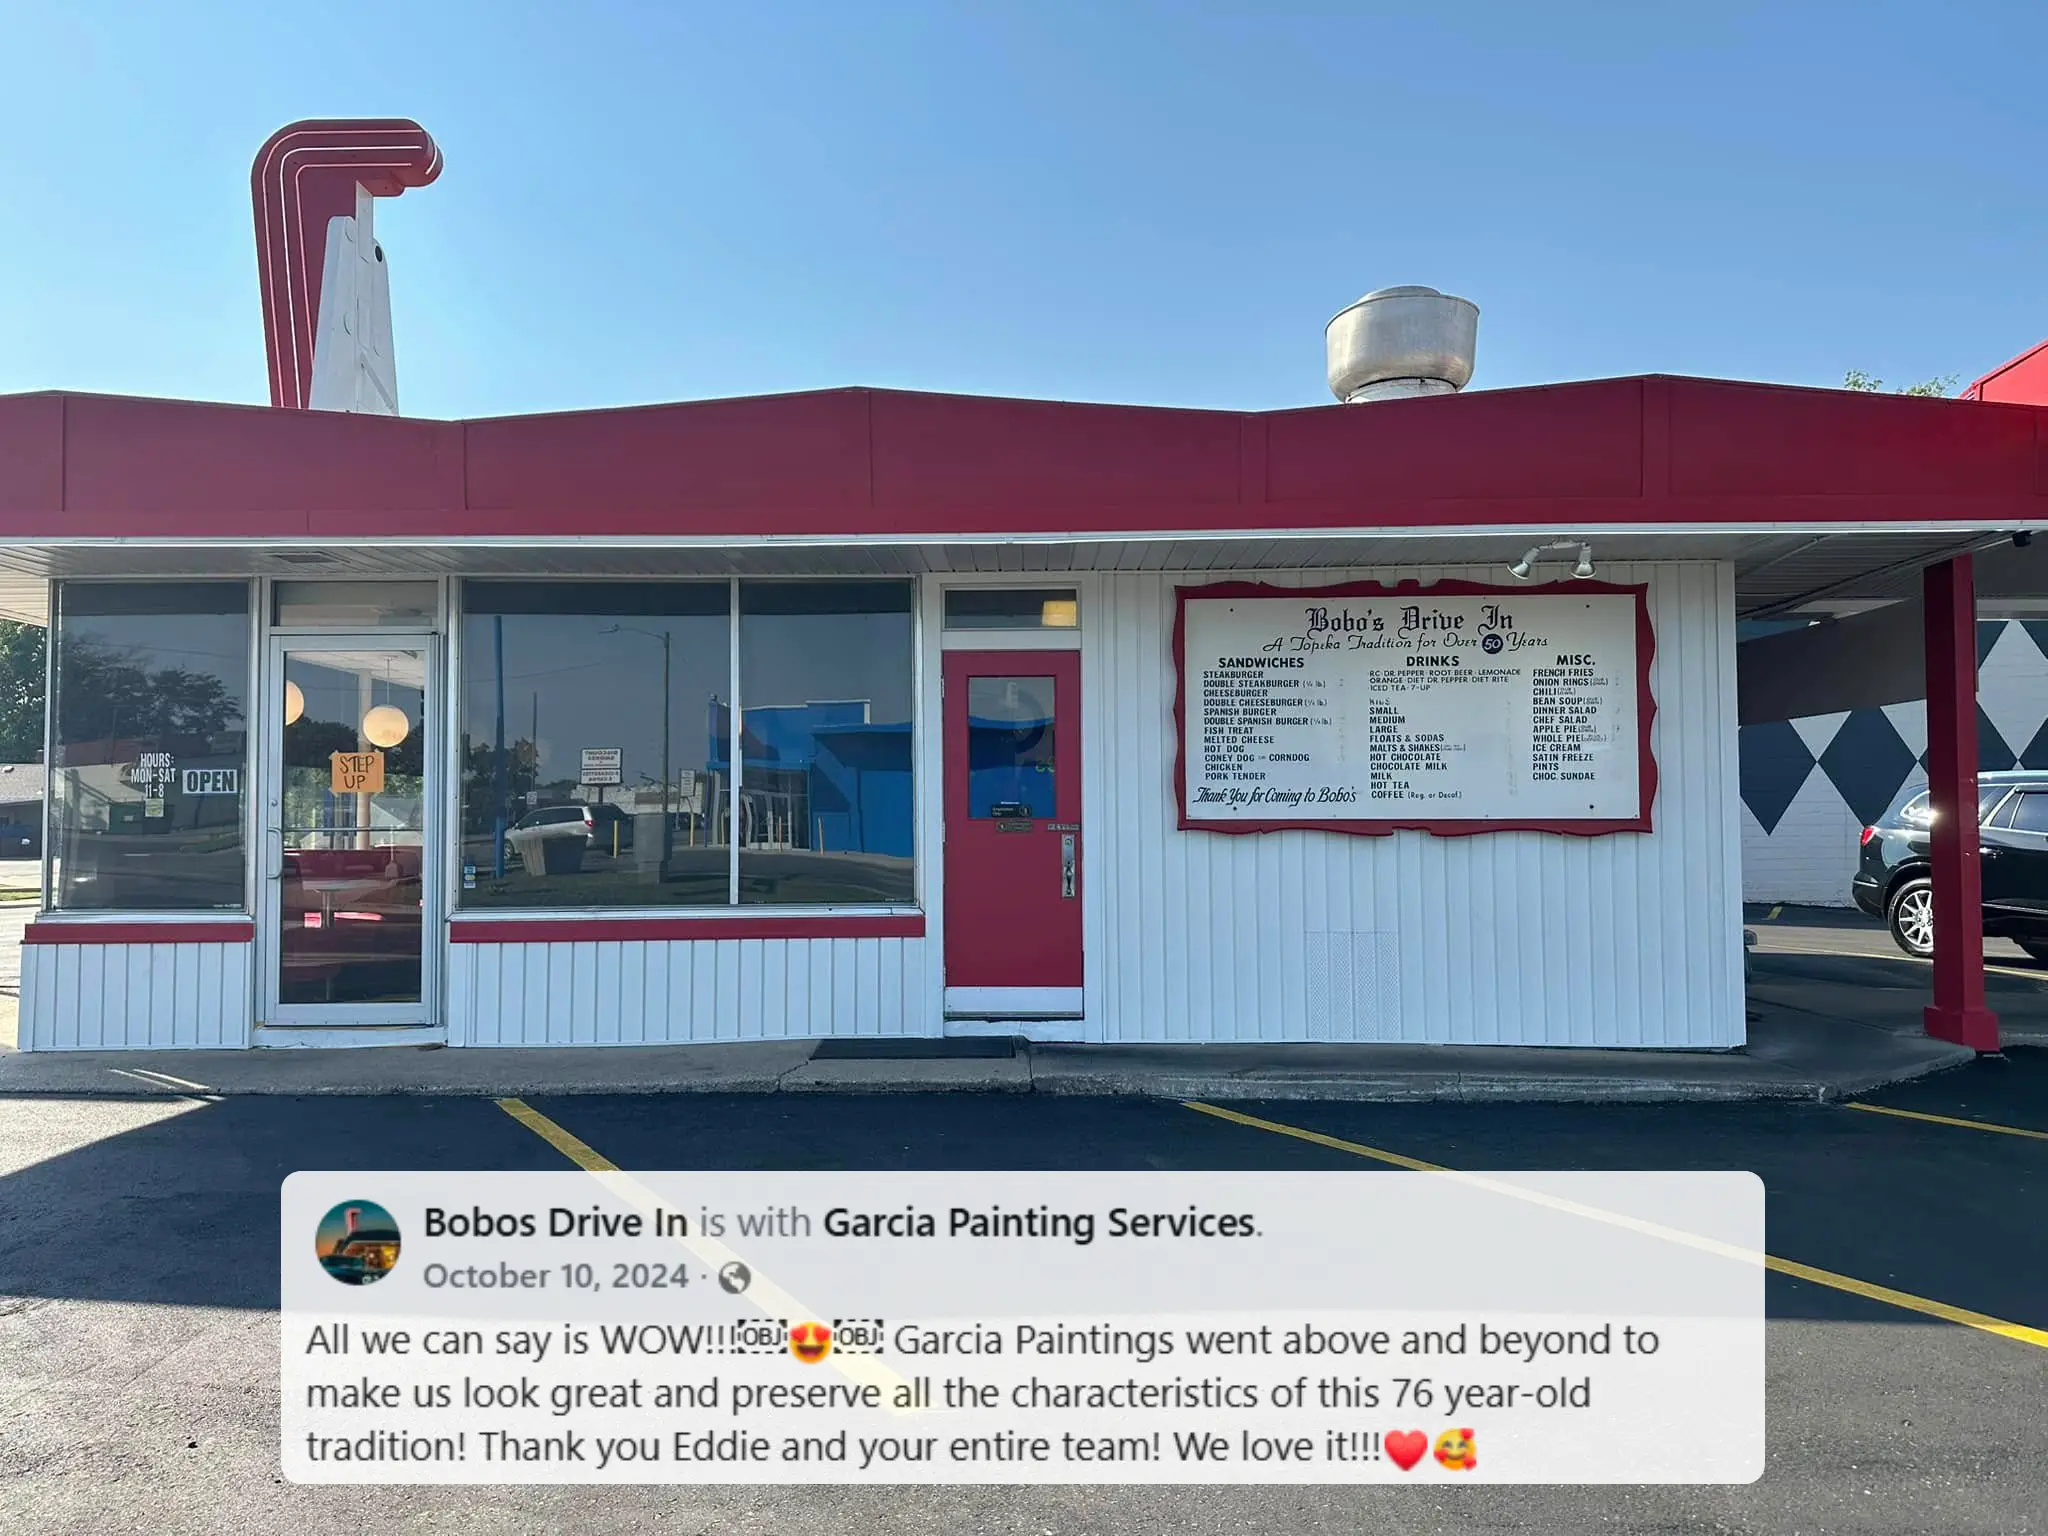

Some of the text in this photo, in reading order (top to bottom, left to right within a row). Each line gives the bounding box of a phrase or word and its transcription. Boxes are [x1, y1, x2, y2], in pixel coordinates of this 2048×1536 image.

[1305, 604, 1513, 639] Bobo's Drive In
[1263, 631, 1547, 655] A Topeka Tradition for Over 50 Years
[1219, 658, 1304, 668] SANDWICHES
[1407, 656, 1459, 666] DRINKS
[1557, 655, 1595, 665] MISC.
[1569, 668, 1593, 676] FRIES
[1533, 678, 1559, 686] ONION
[1204, 689, 1268, 697] CHEESEBURGER
[1204, 698, 1302, 706] DOUBLE CHEESEBURGER
[1533, 697, 1555, 705] BEAN
[1559, 697, 1582, 705] SOUP
[1204, 708, 1276, 716] SPANISH BURGER
[1204, 717, 1308, 725] DOUBLE SPANISH BURGER
[1370, 716, 1405, 724] MEDIUM
[1533, 716, 1587, 724] CHEF SALAD
[1370, 725, 1398, 733] LARGE
[1533, 725, 1560, 733] APPLE
[1204, 736, 1275, 744] MELTED CHEESE
[1370, 734, 1444, 742] FLOATS & SODAS
[1370, 744, 1397, 752] MALTS
[1400, 744, 1405, 752] &
[1408, 744, 1440, 752] SHAKES
[140, 753, 174, 767] HOURS:
[1205, 754, 1232, 762] CONEY
[1237, 754, 1254, 762] DOG
[1370, 753, 1441, 761] HOT CHOCOLATE
[340, 755, 374, 773] STEP
[1426, 762, 1447, 770] MILK
[131, 768, 176, 783] MON-SAT
[1206, 772, 1266, 780] PORK TENDER
[1371, 772, 1392, 780] MILK
[1560, 772, 1596, 780] SUNDAE
[187, 771, 234, 792] OPEN
[344, 775, 365, 789] UP
[1371, 781, 1409, 789] HOT TEA
[145, 784, 164, 798] 11-8
[1371, 791, 1404, 799] COFFEE
[1193, 786, 1356, 807] Thank You for Coming to Bobo's
